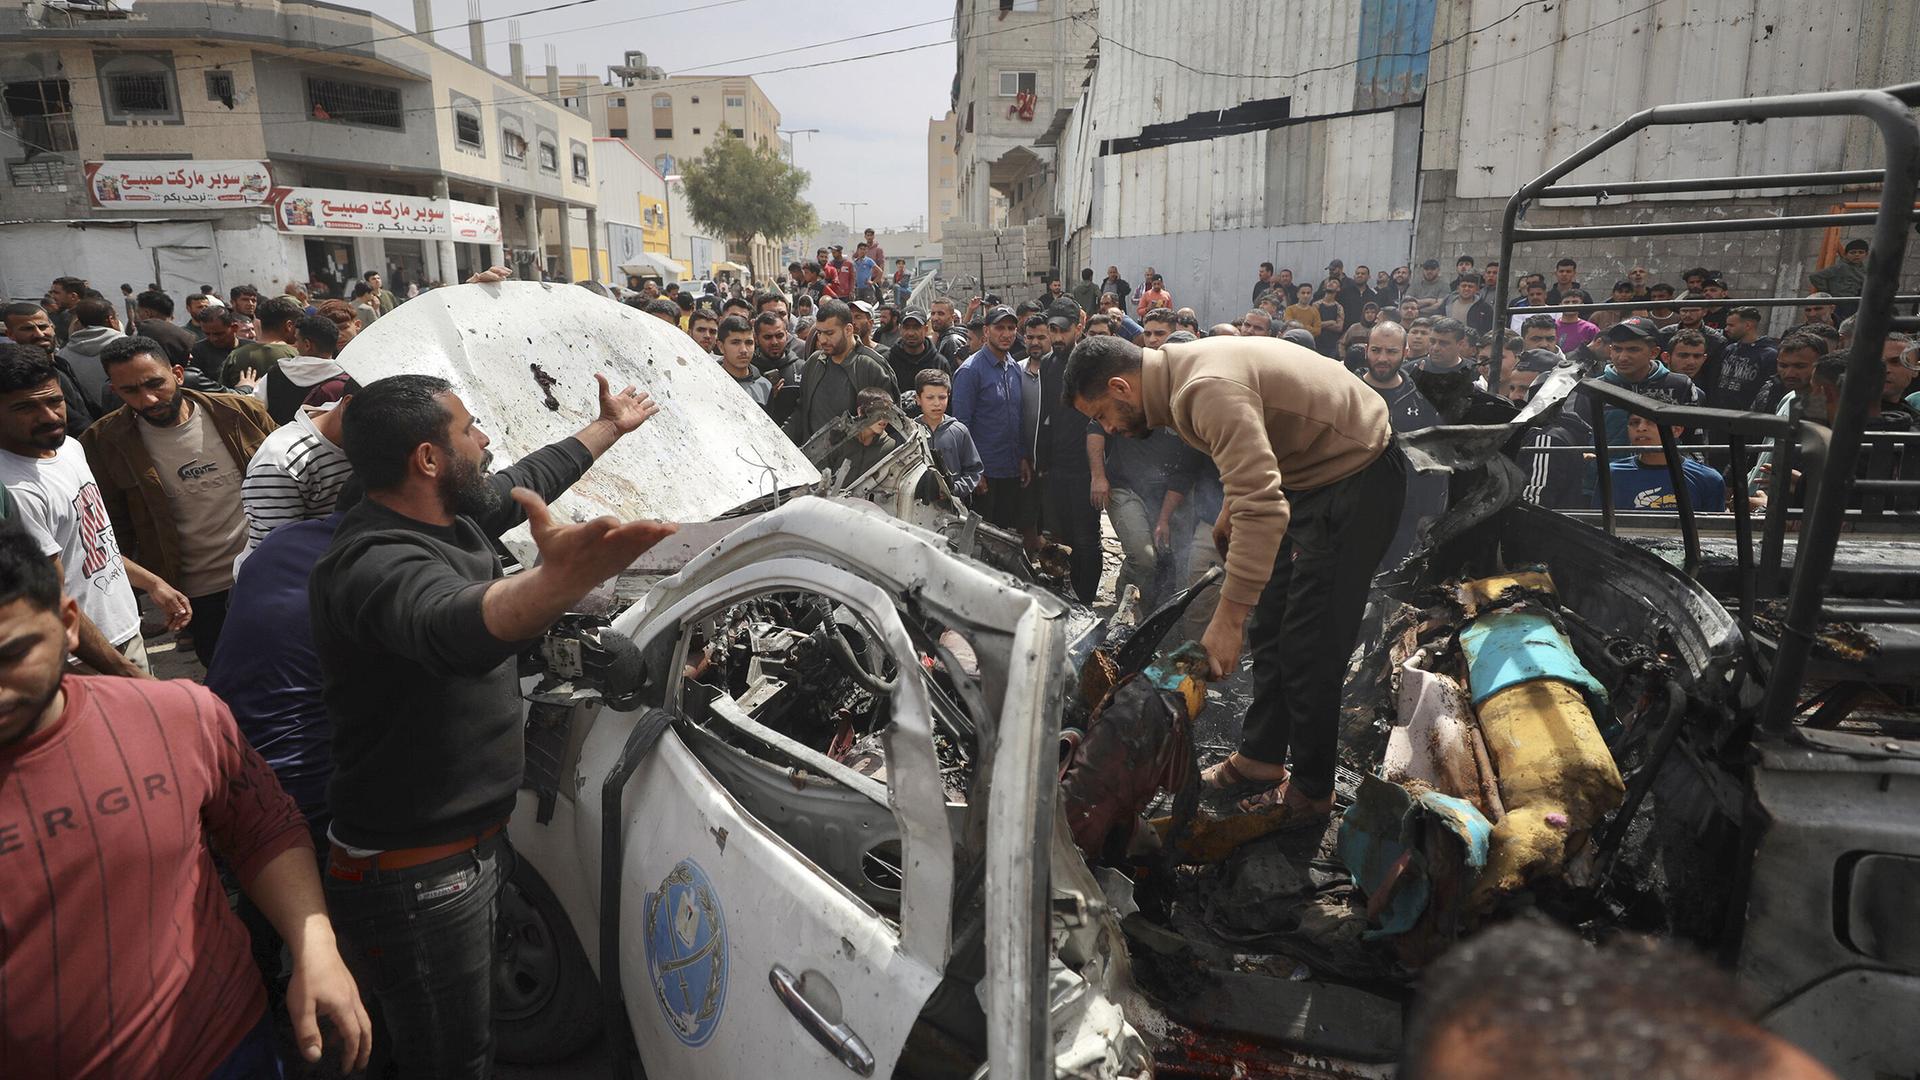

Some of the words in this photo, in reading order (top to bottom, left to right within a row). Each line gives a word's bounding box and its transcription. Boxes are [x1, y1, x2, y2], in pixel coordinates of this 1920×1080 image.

[120, 173, 164, 190] صبيح
[166, 169, 204, 189] ماركت
[207, 173, 240, 190] سوبر
[162, 192, 181, 203] بكم
[181, 192, 207, 203] نرحب
[320, 199, 369, 218] صبيح
[371, 199, 410, 220] ماركت
[413, 206, 444, 222] سوبر
[376, 222, 405, 233] بكم
[406, 224, 436, 235] نرحب
[176, 469, 241, 496] ACOSTE
